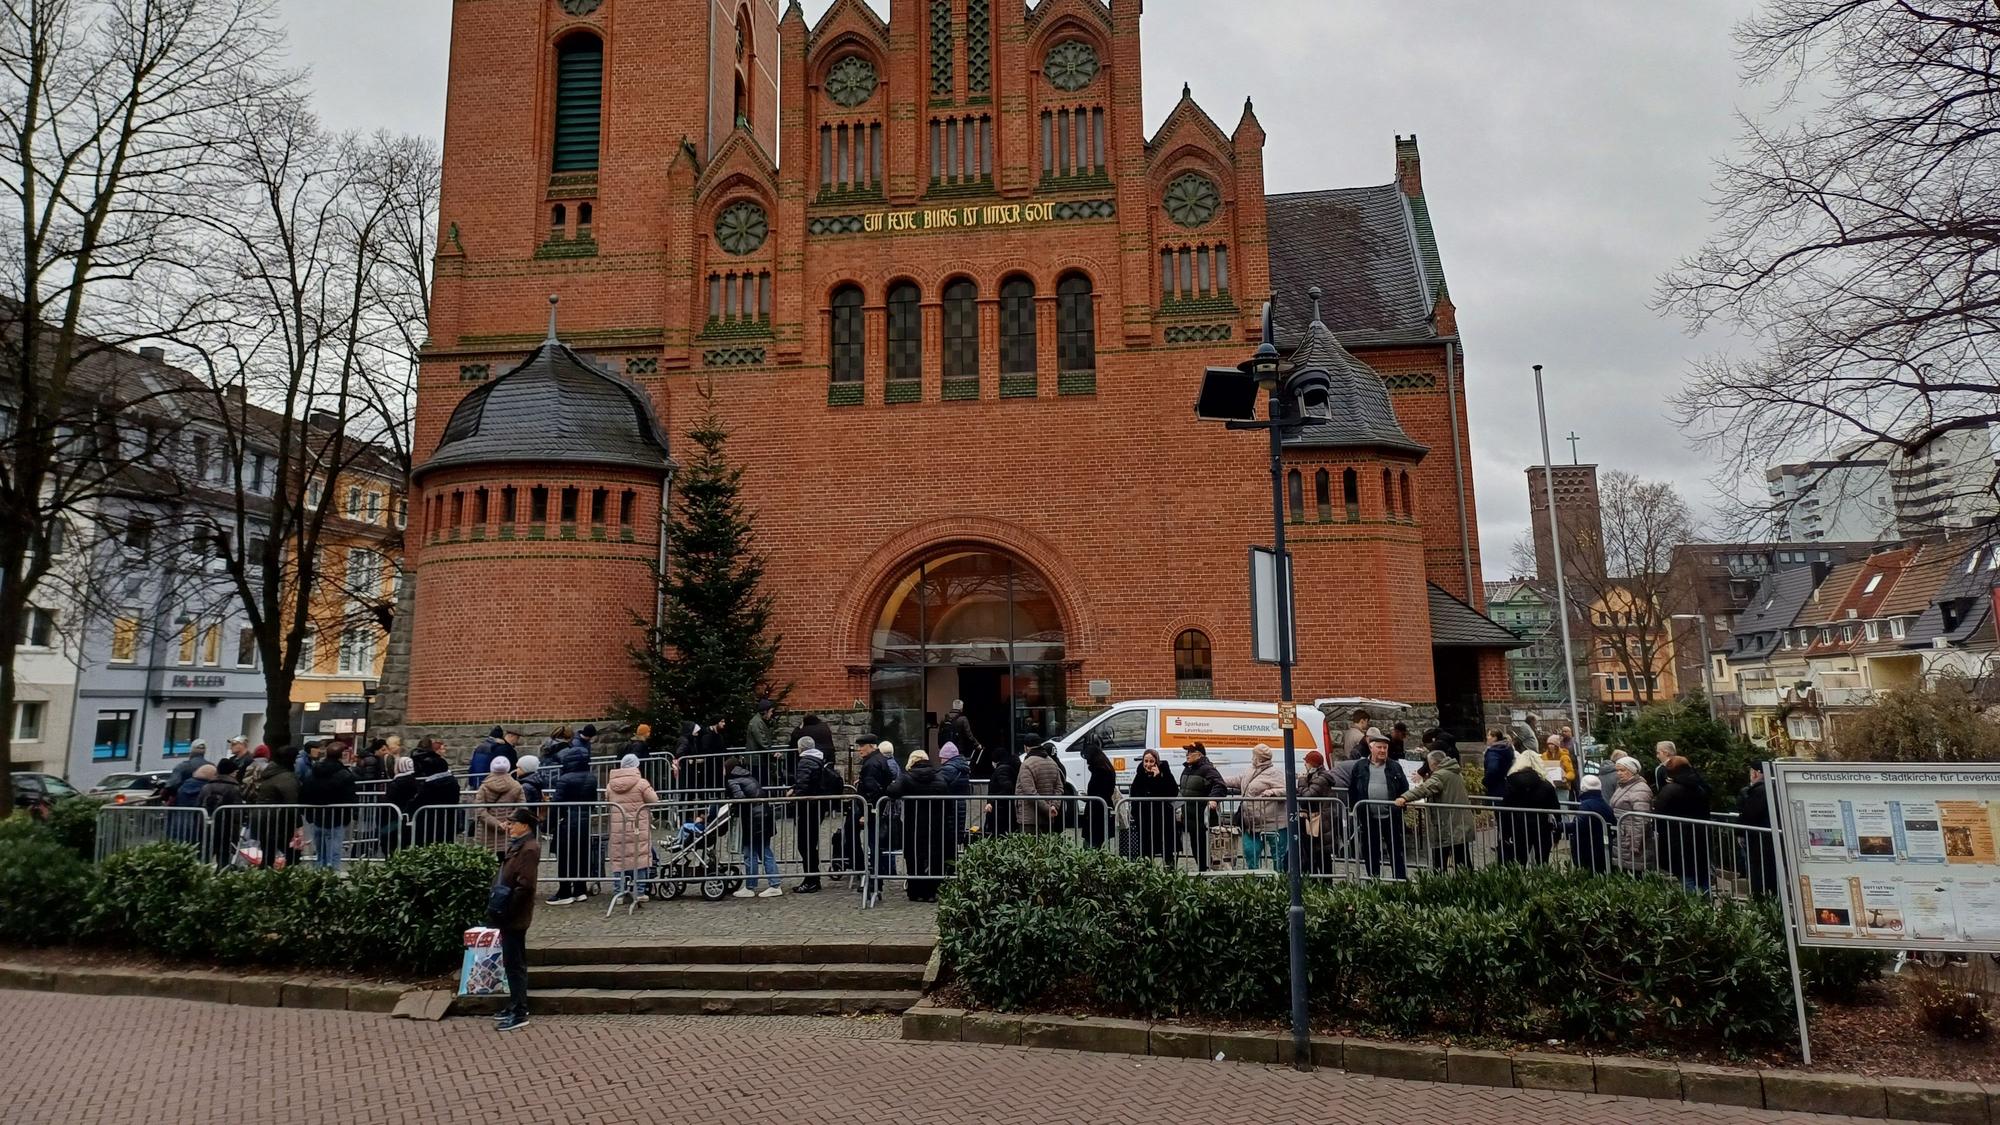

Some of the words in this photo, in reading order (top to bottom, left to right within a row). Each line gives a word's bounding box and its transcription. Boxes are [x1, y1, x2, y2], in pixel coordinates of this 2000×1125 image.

[864, 213, 884, 232] EIN
[888, 211, 917, 230] FESTE
[924, 208, 957, 229] BURG
[963, 206, 980, 226] IST
[983, 204, 1021, 225] UNSER
[1025, 202, 1056, 222] GOTT
[1184, 720, 1210, 728] Sparkasse
[1233, 724, 1271, 732] CHEMPARK
[1801, 771, 1872, 782] Christuskirche
[1880, 771, 1938, 782] Stadtkirche
